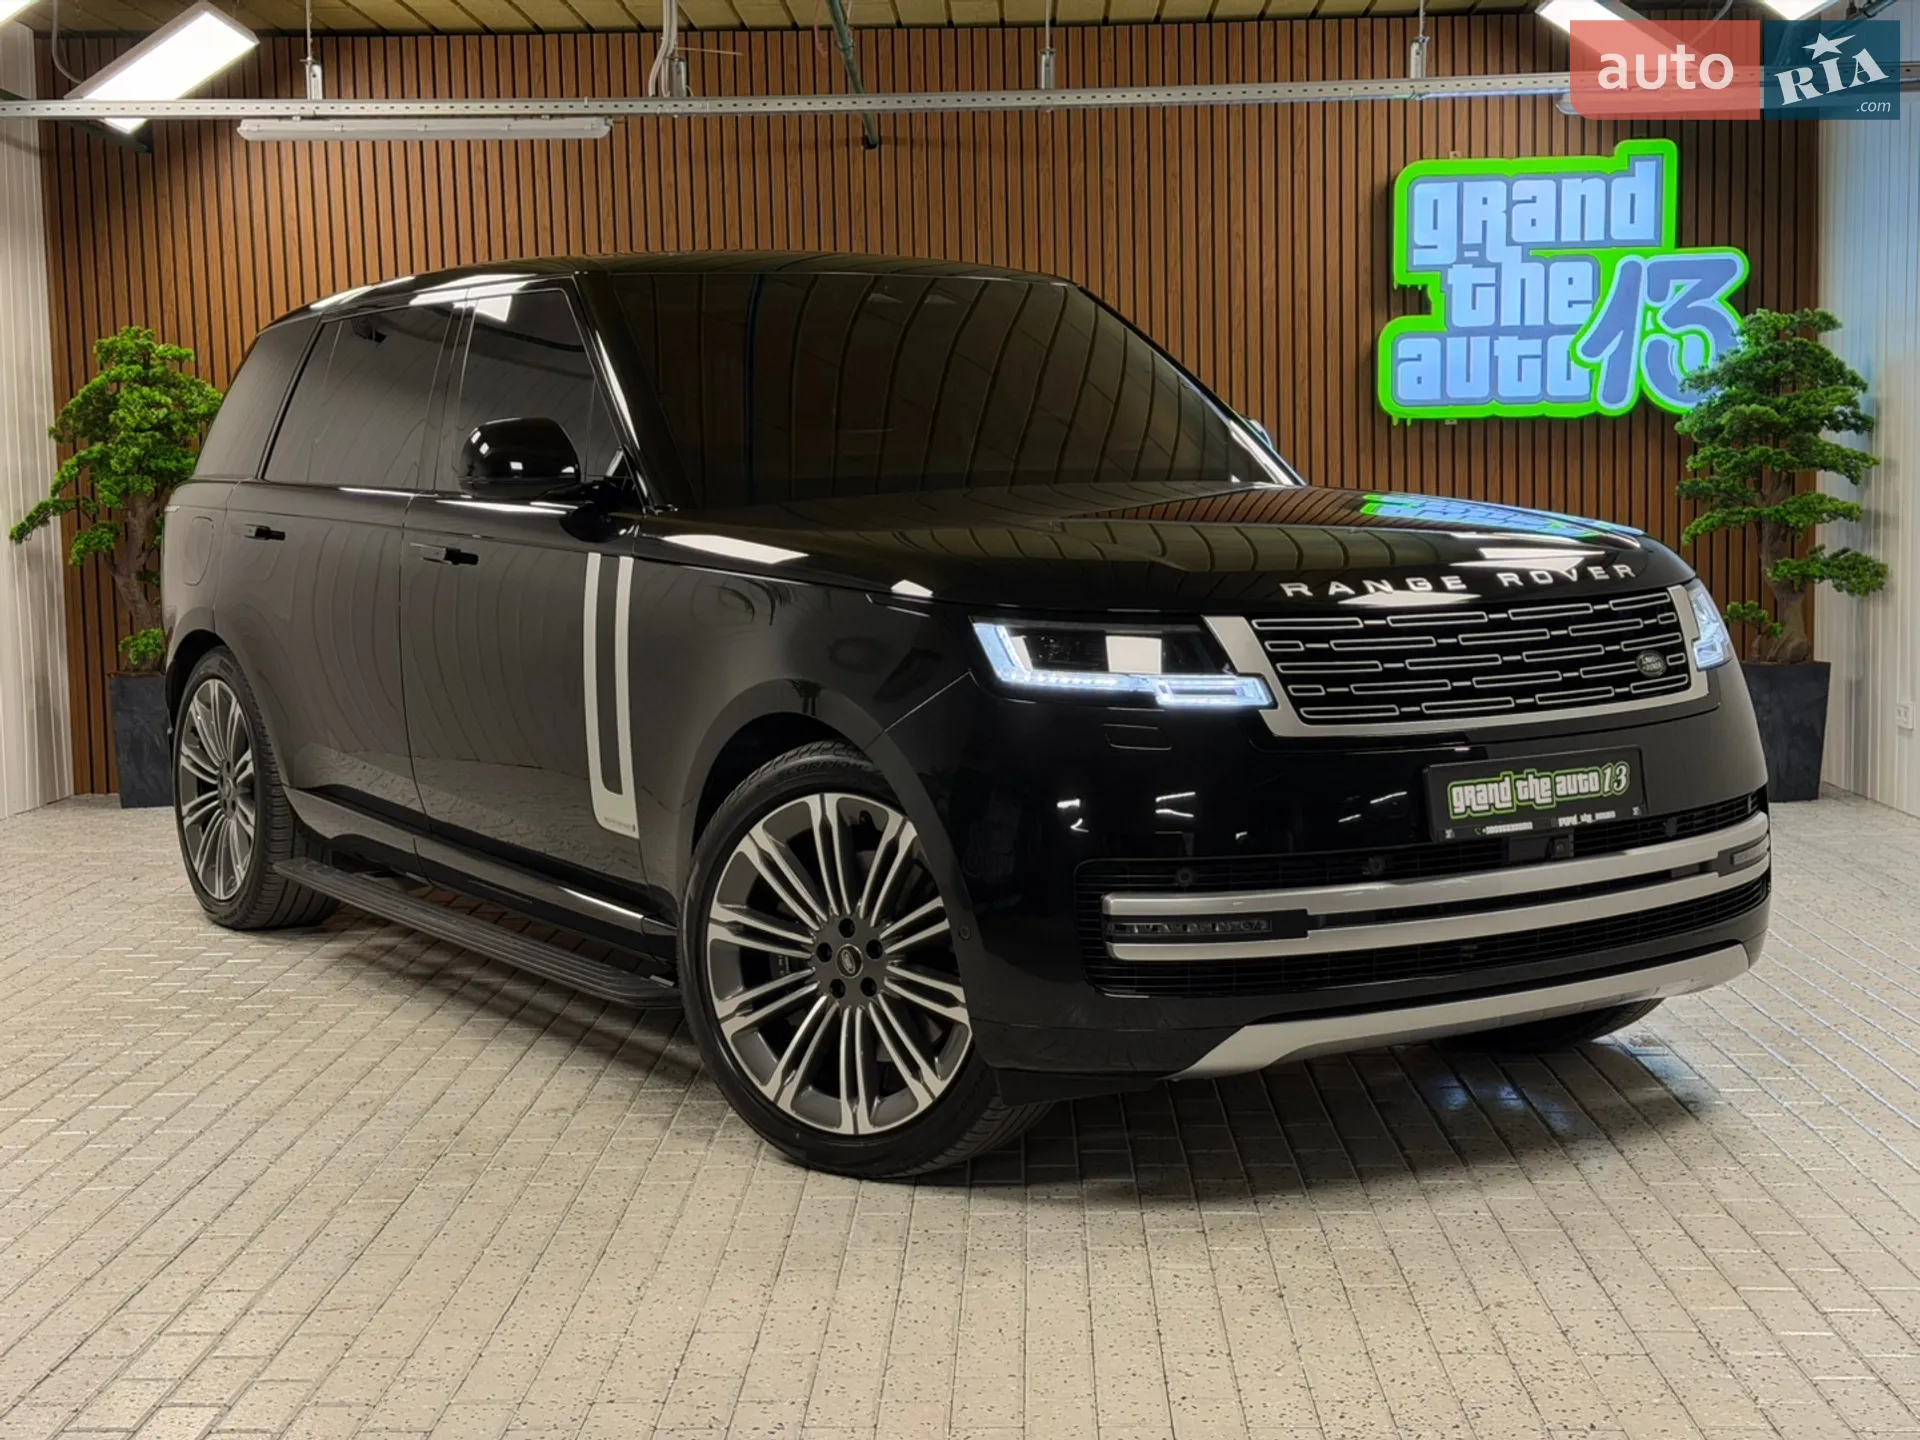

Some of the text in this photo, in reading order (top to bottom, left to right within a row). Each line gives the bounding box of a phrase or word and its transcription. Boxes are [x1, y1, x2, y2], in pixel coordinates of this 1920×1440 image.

[1448, 245, 1593, 327] the
[1575, 254, 1744, 410] 13
[1397, 334, 1592, 400] auto
[1279, 564, 1636, 598] RANGE ROVER
[1516, 774, 1552, 804] the
[1555, 771, 1600, 796] auto
[1602, 765, 1628, 793] 13
